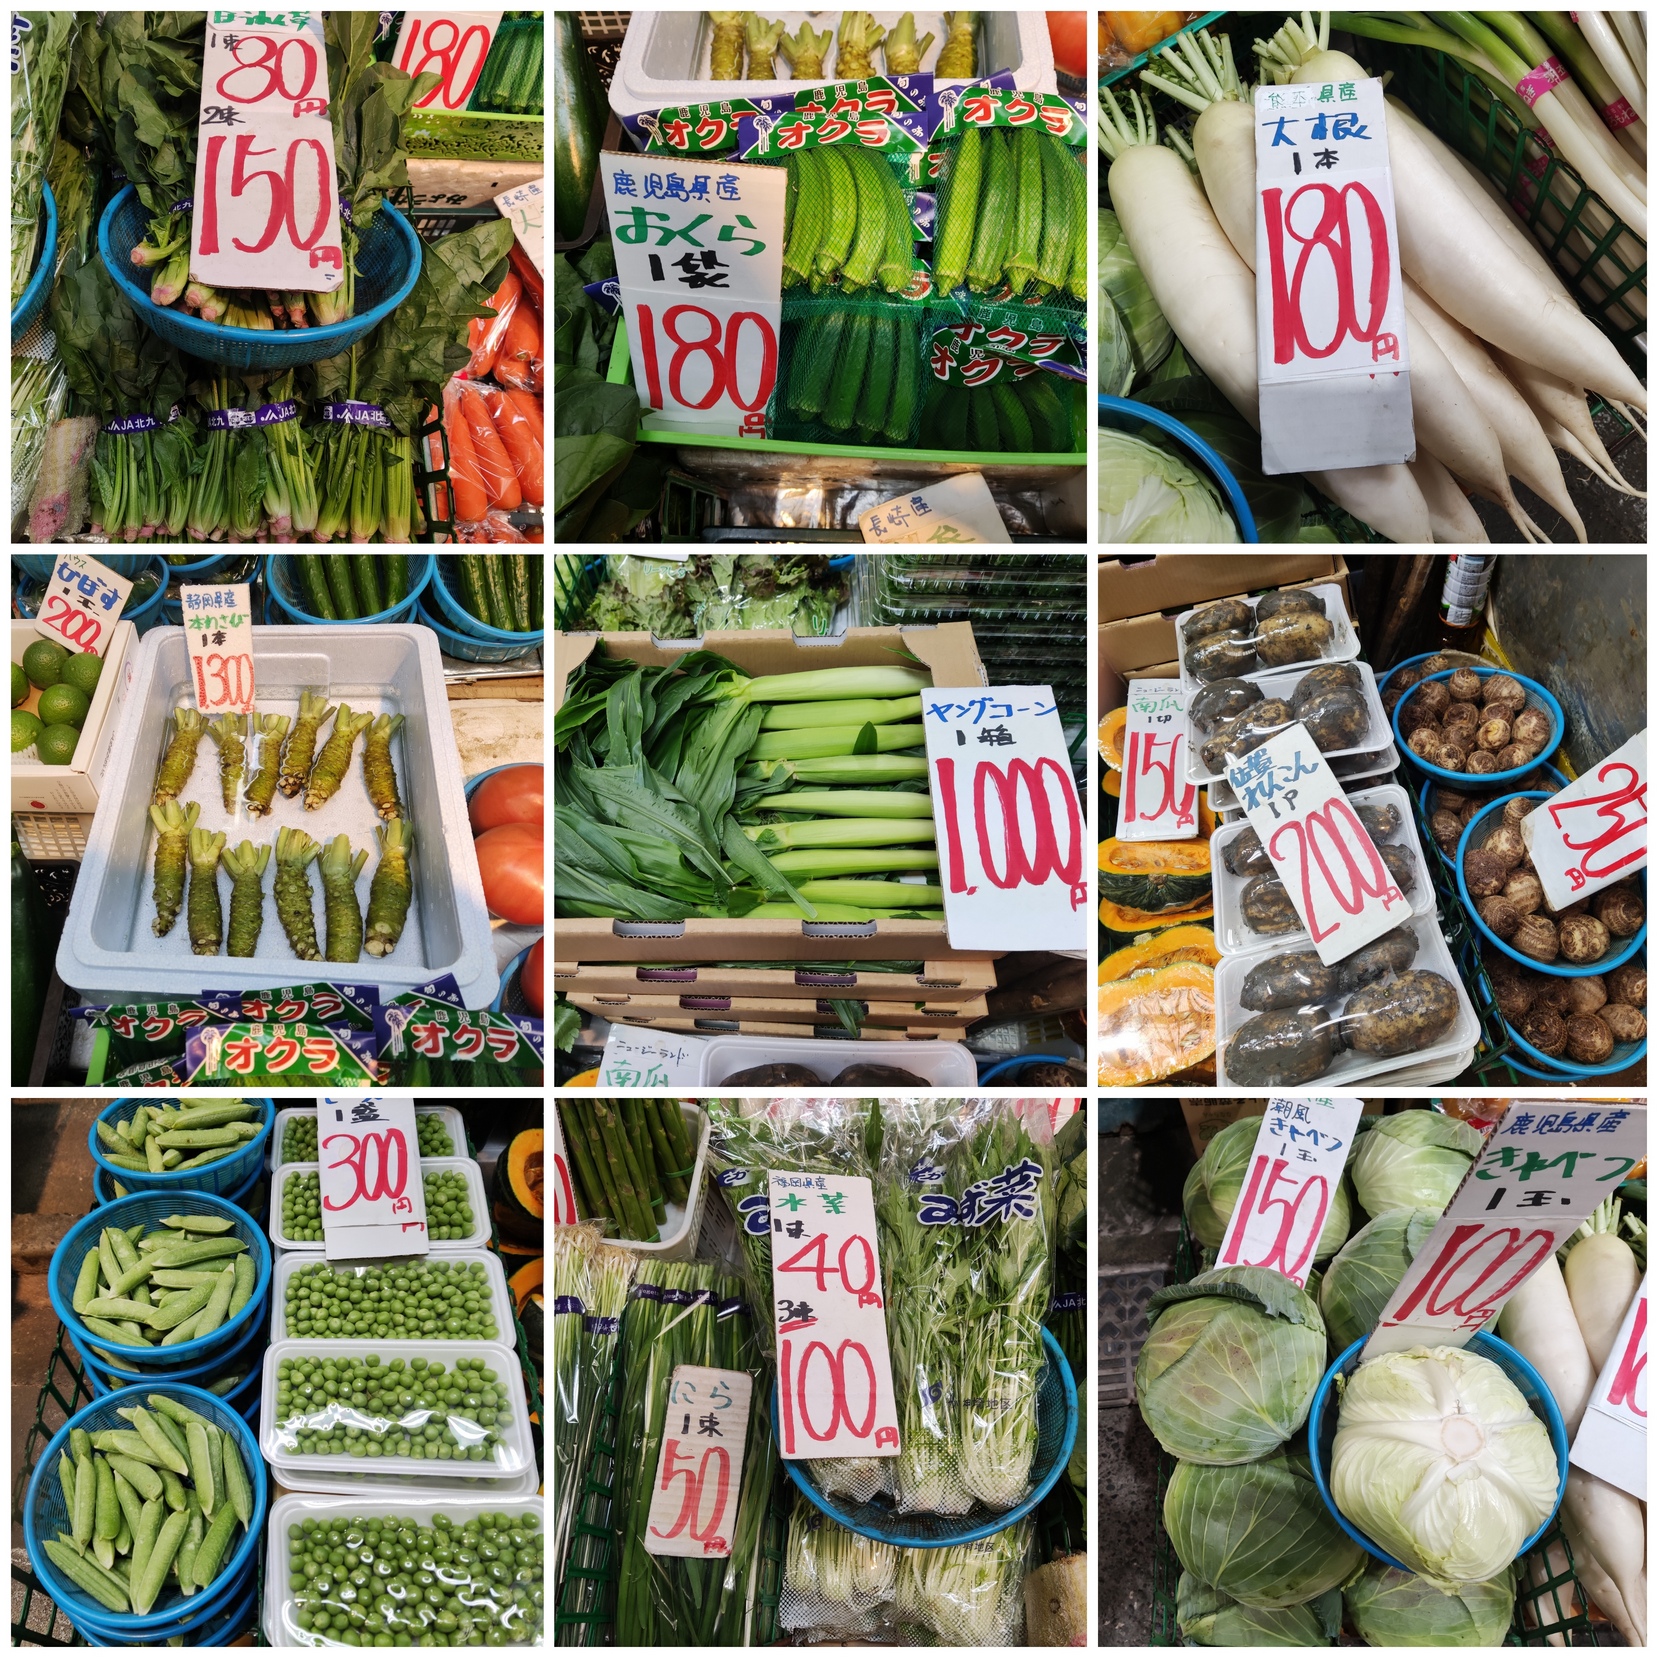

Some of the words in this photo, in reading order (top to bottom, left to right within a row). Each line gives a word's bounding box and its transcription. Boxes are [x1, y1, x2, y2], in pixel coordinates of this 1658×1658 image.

[400, 19, 491, 110] 180
[813, 80, 869, 103] 鹿児島
[678, 101, 733, 119] 鹿児島
[963, 95, 1074, 138] オクラ
[778, 118, 891, 150] オクラ
[1262, 112, 1372, 147] 大根
[1292, 147, 1340, 175] 1本
[612, 169, 742, 203] 鹿児島県産
[614, 206, 767, 257] おくら
[648, 250, 731, 289] 1袋
[185, 589, 238, 611] 静岡県産
[188, 612, 250, 631] 本わさび
[201, 630, 228, 648] 1本
[926, 697, 1057, 724] ヤングコーン
[1131, 695, 1184, 713] 南瓜
[956, 725, 1016, 747] 1箱
[260, 985, 316, 1001] 鹿児島
[126, 1003, 180, 1017] 鹿児島
[435, 1009, 491, 1027] 鹿児島
[250, 1024, 308, 1038] 鹿児島
[410, 1020, 521, 1064] オクラ
[224, 1035, 341, 1074] オクラ
[605, 1059, 669, 1087] 南瓜
[1270, 1098, 1312, 1125] 潮風
[1500, 1109, 1631, 1136] 鹿児島県産
[1270, 1116, 1343, 1152] きゃべつ
[1475, 1146, 1636, 1182] きゃべつ
[775, 1191, 850, 1215] 水菜
[671, 1380, 733, 1411] にら
[681, 1412, 724, 1438] 1束
